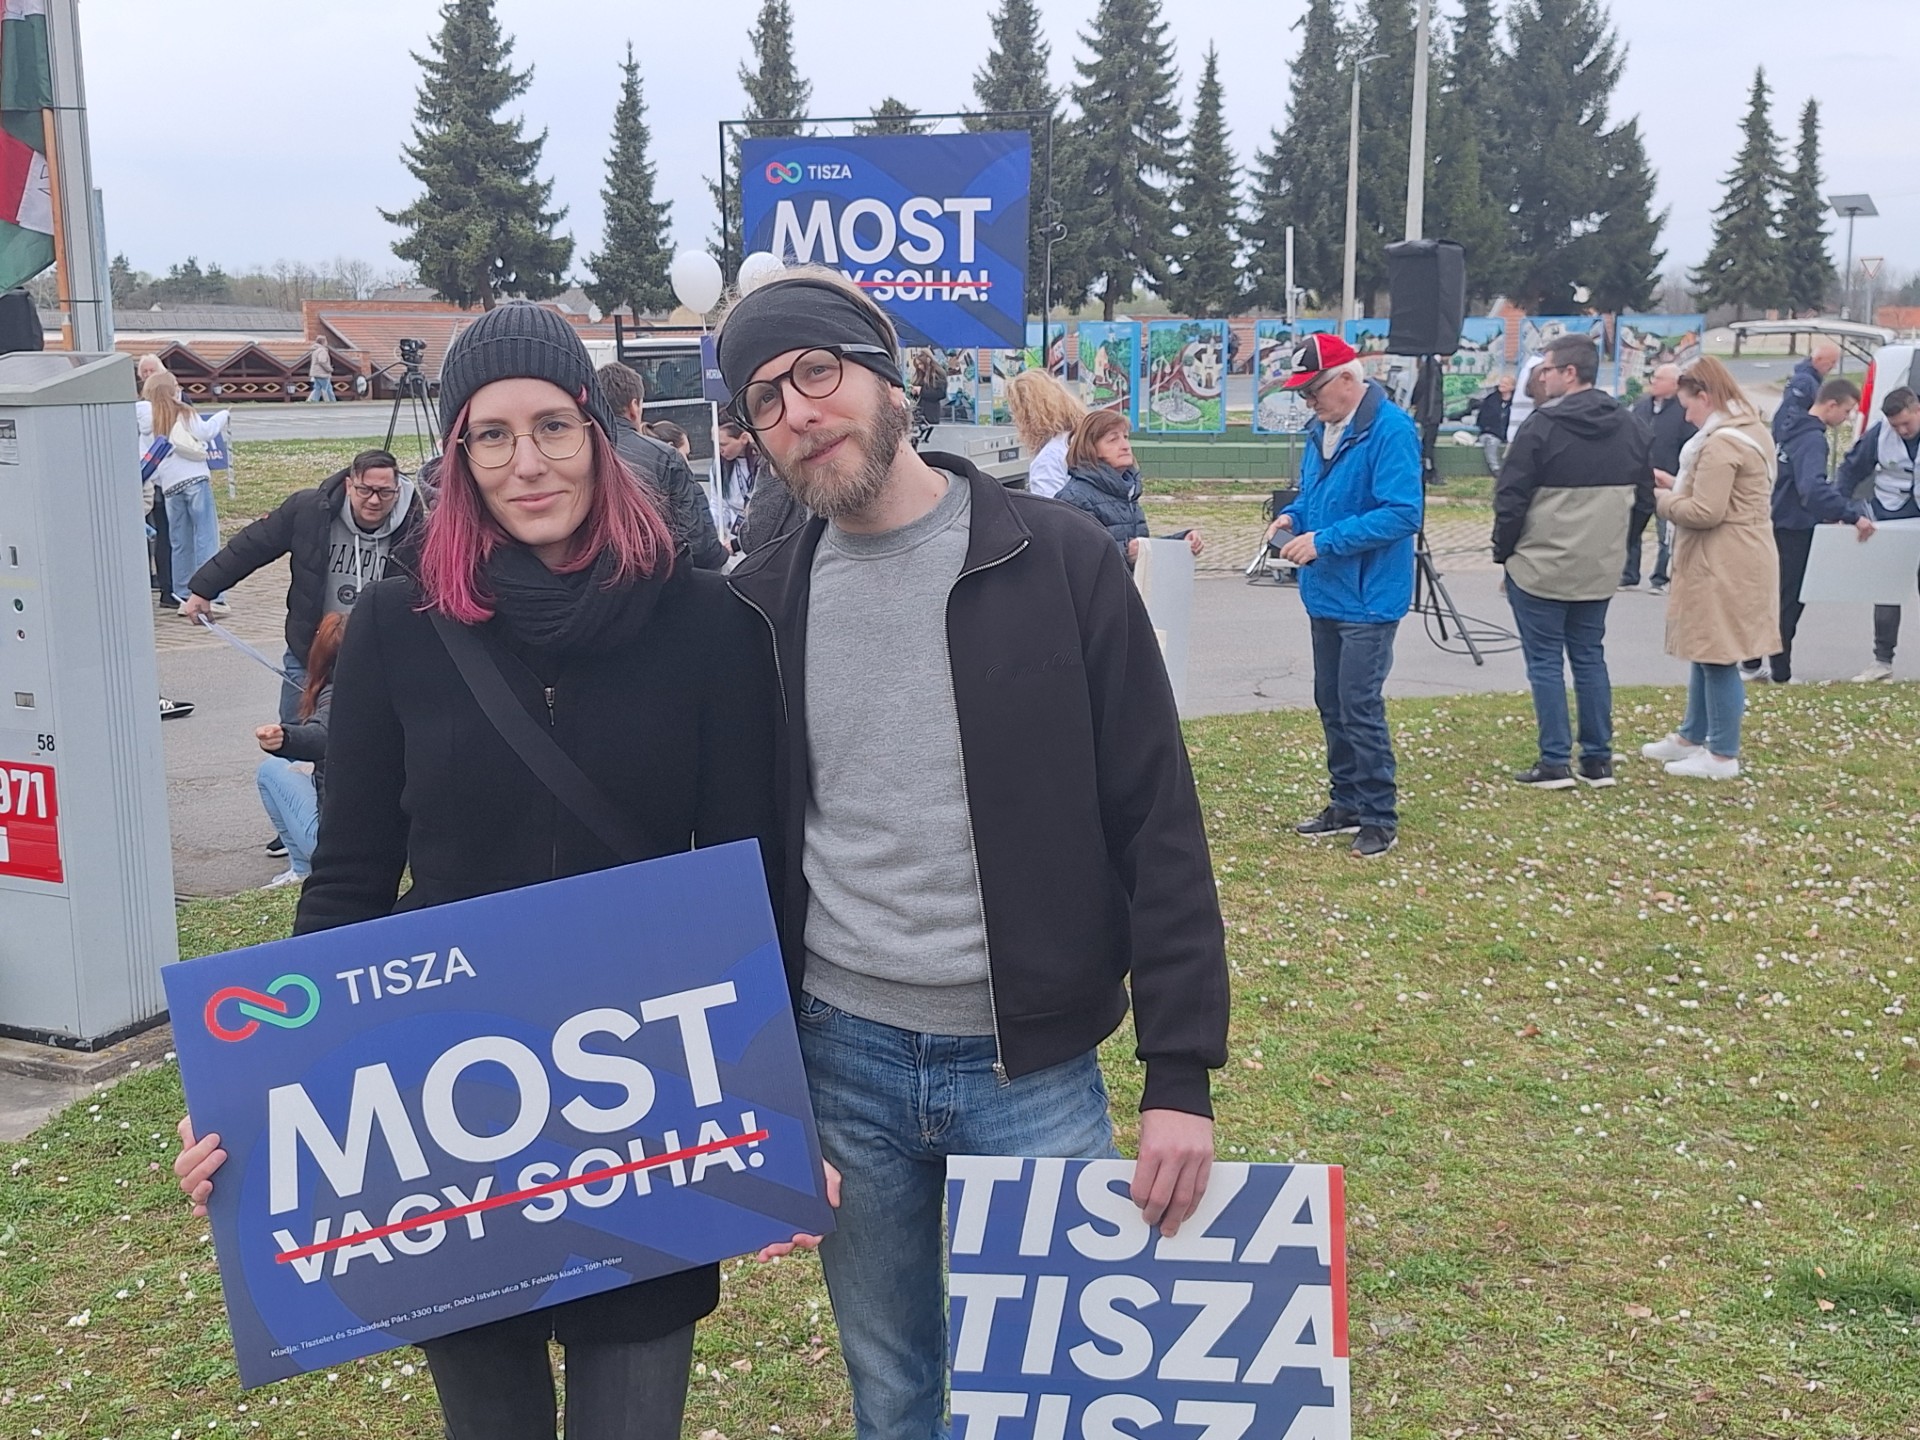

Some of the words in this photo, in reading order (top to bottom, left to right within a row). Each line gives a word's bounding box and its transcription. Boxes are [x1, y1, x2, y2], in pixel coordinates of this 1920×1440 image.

[807, 164, 852, 180] TISZA
[772, 197, 991, 265] MOST
[873, 269, 989, 302] SOHA!
[37, 733, 56, 752] 58
[336, 946, 477, 1005] TISZA
[268, 980, 738, 1216] MOST
[272, 1176, 494, 1284] VAGY
[517, 1110, 766, 1223] SOHA!
[947, 1155, 1331, 1265] TISZA
[271, 1344, 300, 1358] Kiadja:
[300, 1334, 335, 1350] Tisztelet
[336, 1331, 346, 1340] és
[347, 1320, 391, 1337] Szabadság
[411, 1307, 432, 1319] 3300
[433, 1303, 453, 1313] Eger,
[454, 1296, 475, 1307] Dobó
[476, 1288, 501, 1301] István
[502, 1284, 519, 1295] utca
[520, 1280, 531, 1290] 16.
[532, 1273, 559, 1286] Felelős
[584, 1261, 602, 1273] Tóth
[602, 1256, 623, 1267] Péter
[948, 1273, 1334, 1387] TISZA
